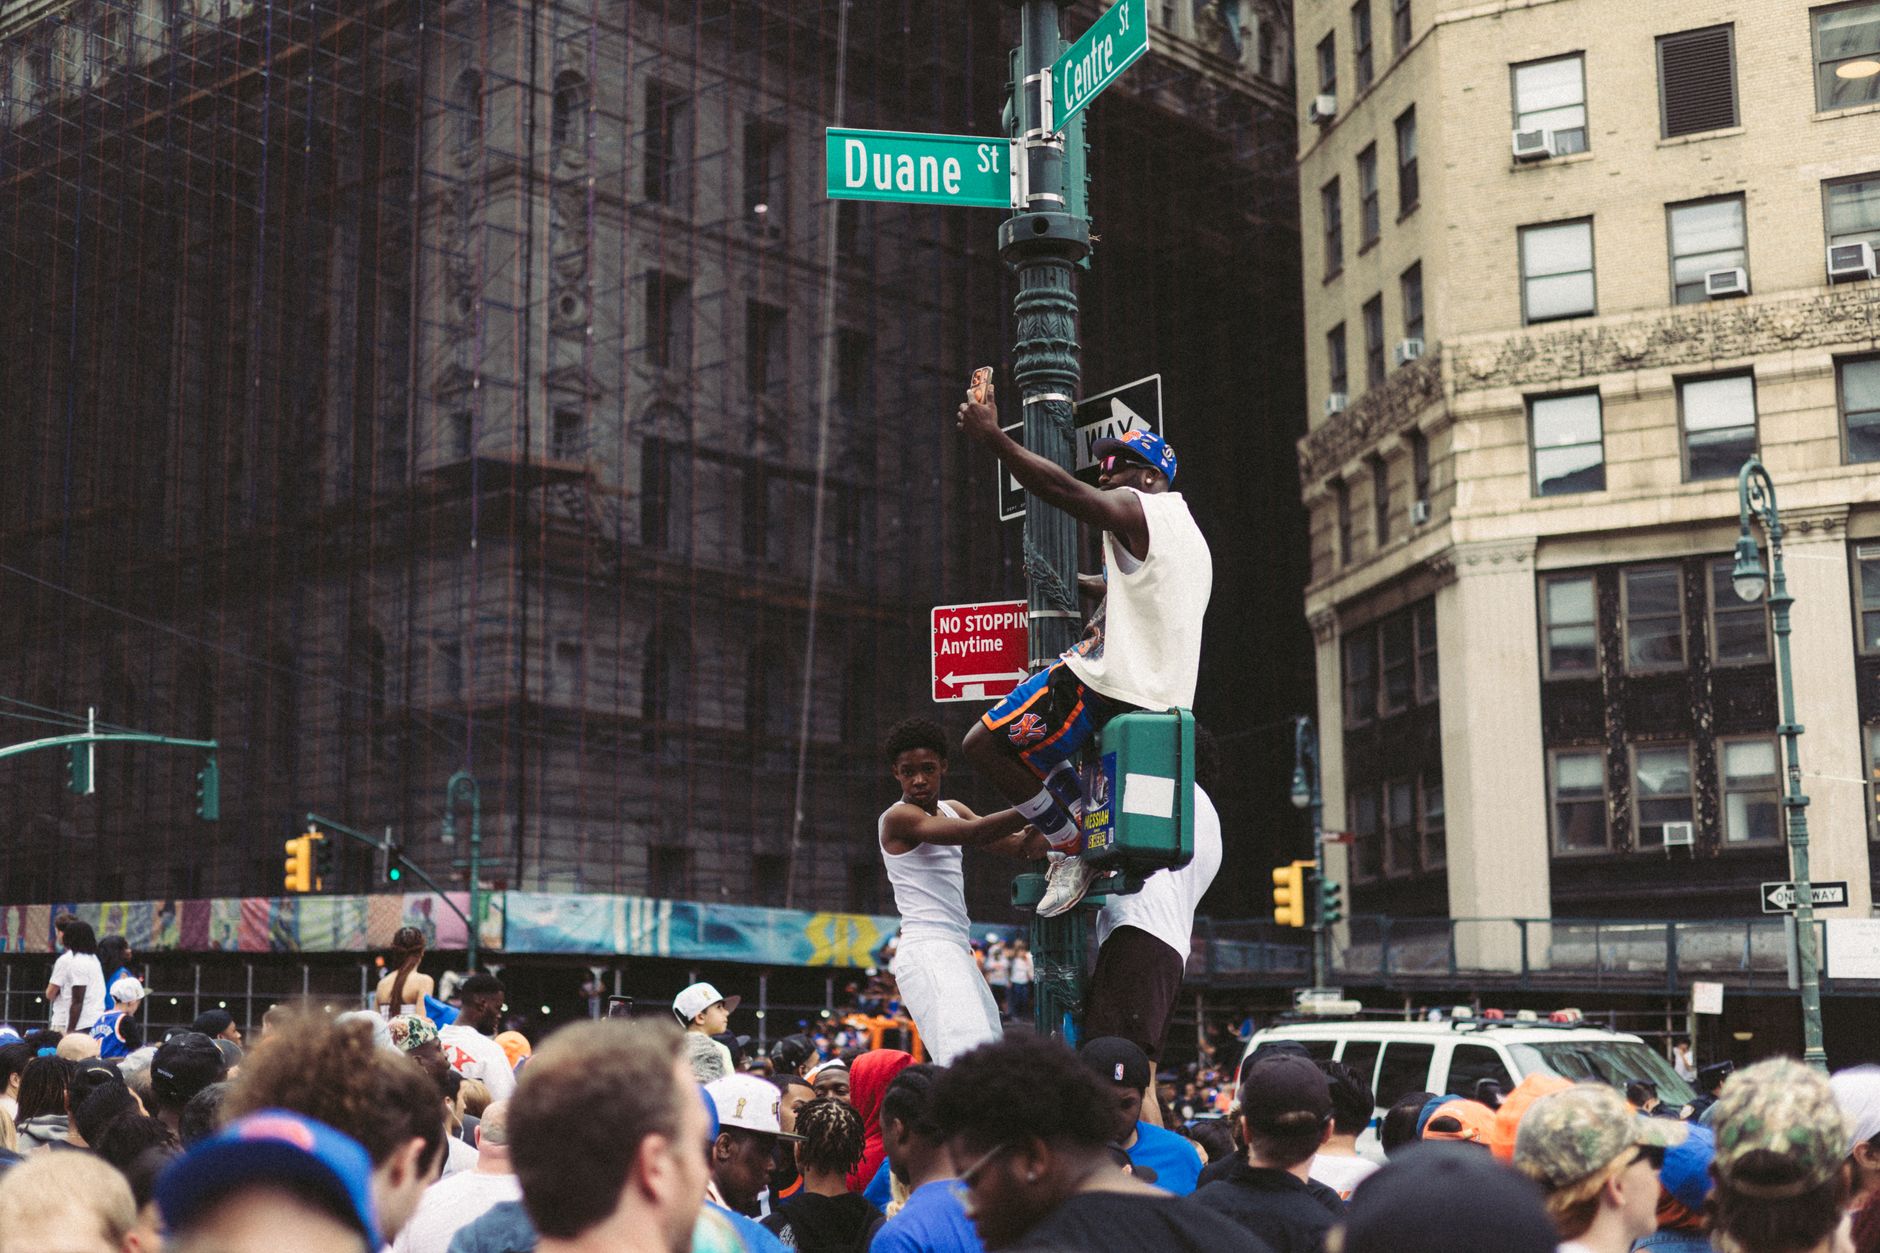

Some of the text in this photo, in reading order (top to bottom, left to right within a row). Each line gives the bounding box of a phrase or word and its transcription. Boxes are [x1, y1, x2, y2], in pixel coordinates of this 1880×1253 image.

[1064, 1, 1129, 110] Centre St
[845, 139, 1000, 195] Duane St
[939, 611, 1028, 634] NO STOPPIN
[941, 635, 1003, 657] Anytime
[1811, 890, 1837, 900] WAY
